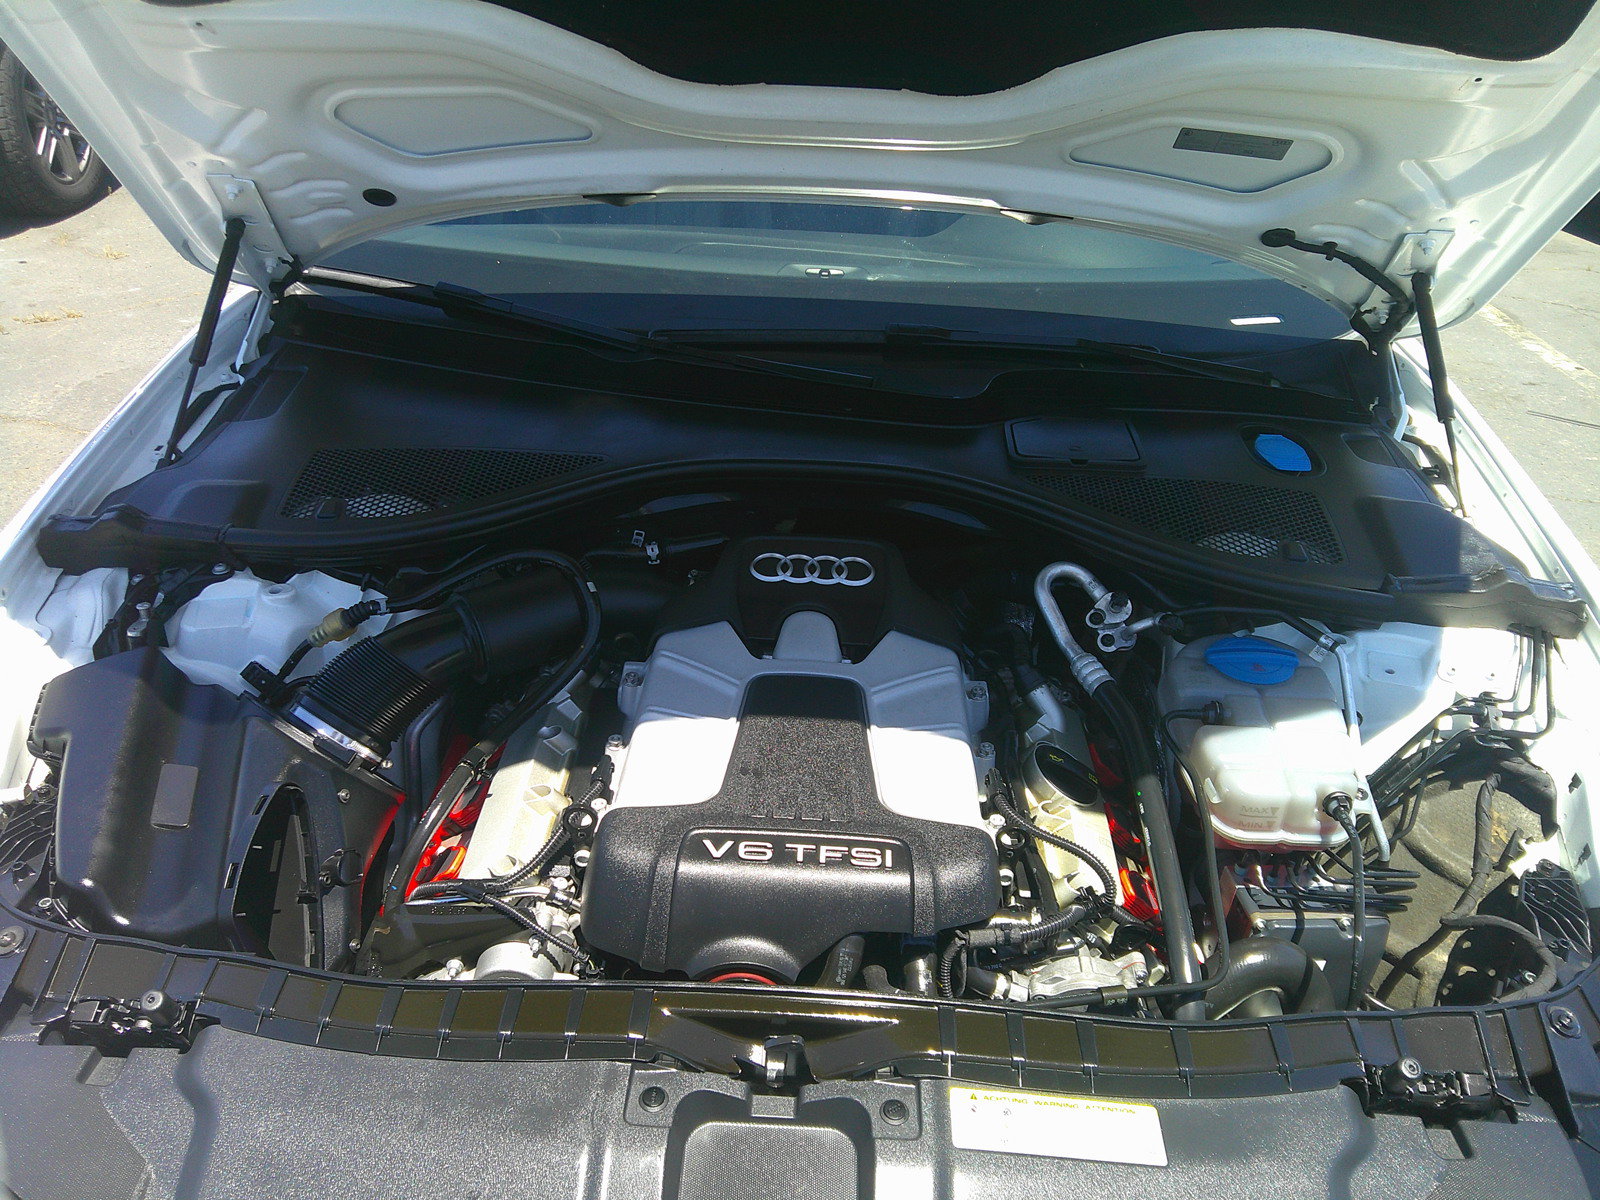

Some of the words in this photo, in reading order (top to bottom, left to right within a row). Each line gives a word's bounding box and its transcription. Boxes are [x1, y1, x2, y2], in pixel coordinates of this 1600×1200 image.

[1241, 805, 1269, 815] MAX
[1240, 820, 1263, 829] MIN
[702, 839, 774, 861] V6
[785, 843, 894, 869] TFSI
[1033, 1100, 1079, 1109] WARNING
